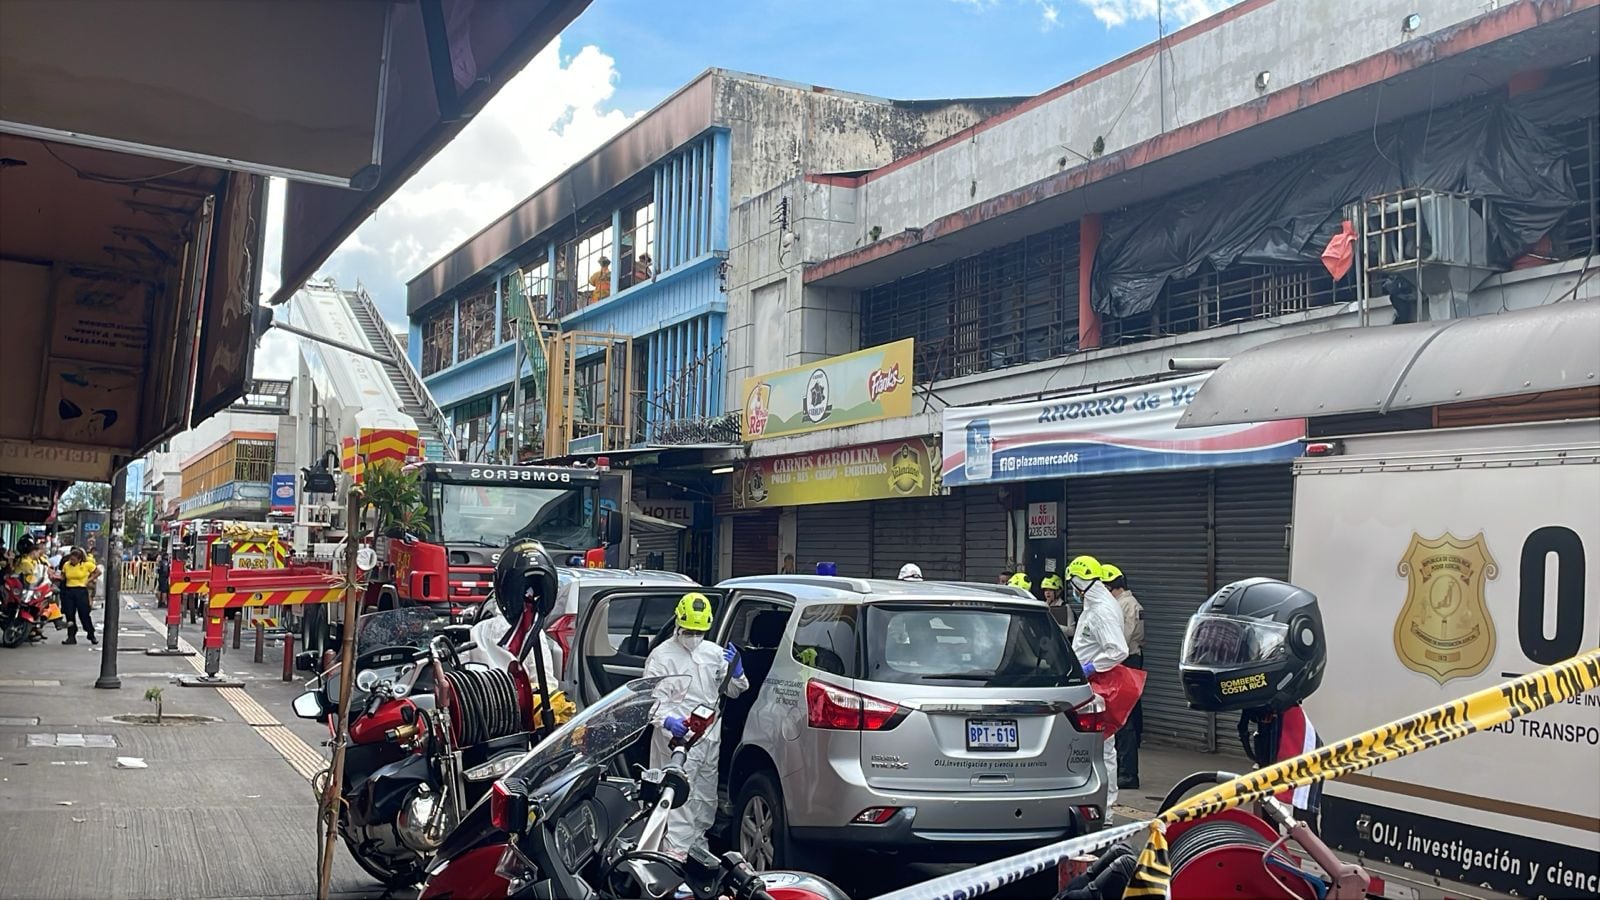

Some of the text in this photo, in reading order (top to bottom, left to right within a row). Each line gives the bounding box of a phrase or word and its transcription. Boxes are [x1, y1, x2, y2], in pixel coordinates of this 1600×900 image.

[1038, 395, 1127, 423] AHORRO
[1133, 391, 1160, 411] de
[749, 415, 766, 435] Rey
[773, 447, 880, 474] CARNES CAROLINA
[1016, 451, 1079, 470] plazamercados
[771, 473, 791, 485] POLLO
[844, 463, 887, 477] EMBUTIDOS
[642, 506, 690, 520] HOTEL
[1039, 504, 1047, 514] SE
[1030, 515, 1056, 526] ALQUILA
[1220, 673, 1266, 689] BOMBEROS
[1222, 680, 1268, 695] COSTA RICA
[1483, 718, 1515, 734] AD
[970, 727, 1016, 743] BPT-619
[1371, 822, 1402, 851] OIJ,
[1406, 829, 1521, 875] investigación
[1527, 861, 1540, 885] y
